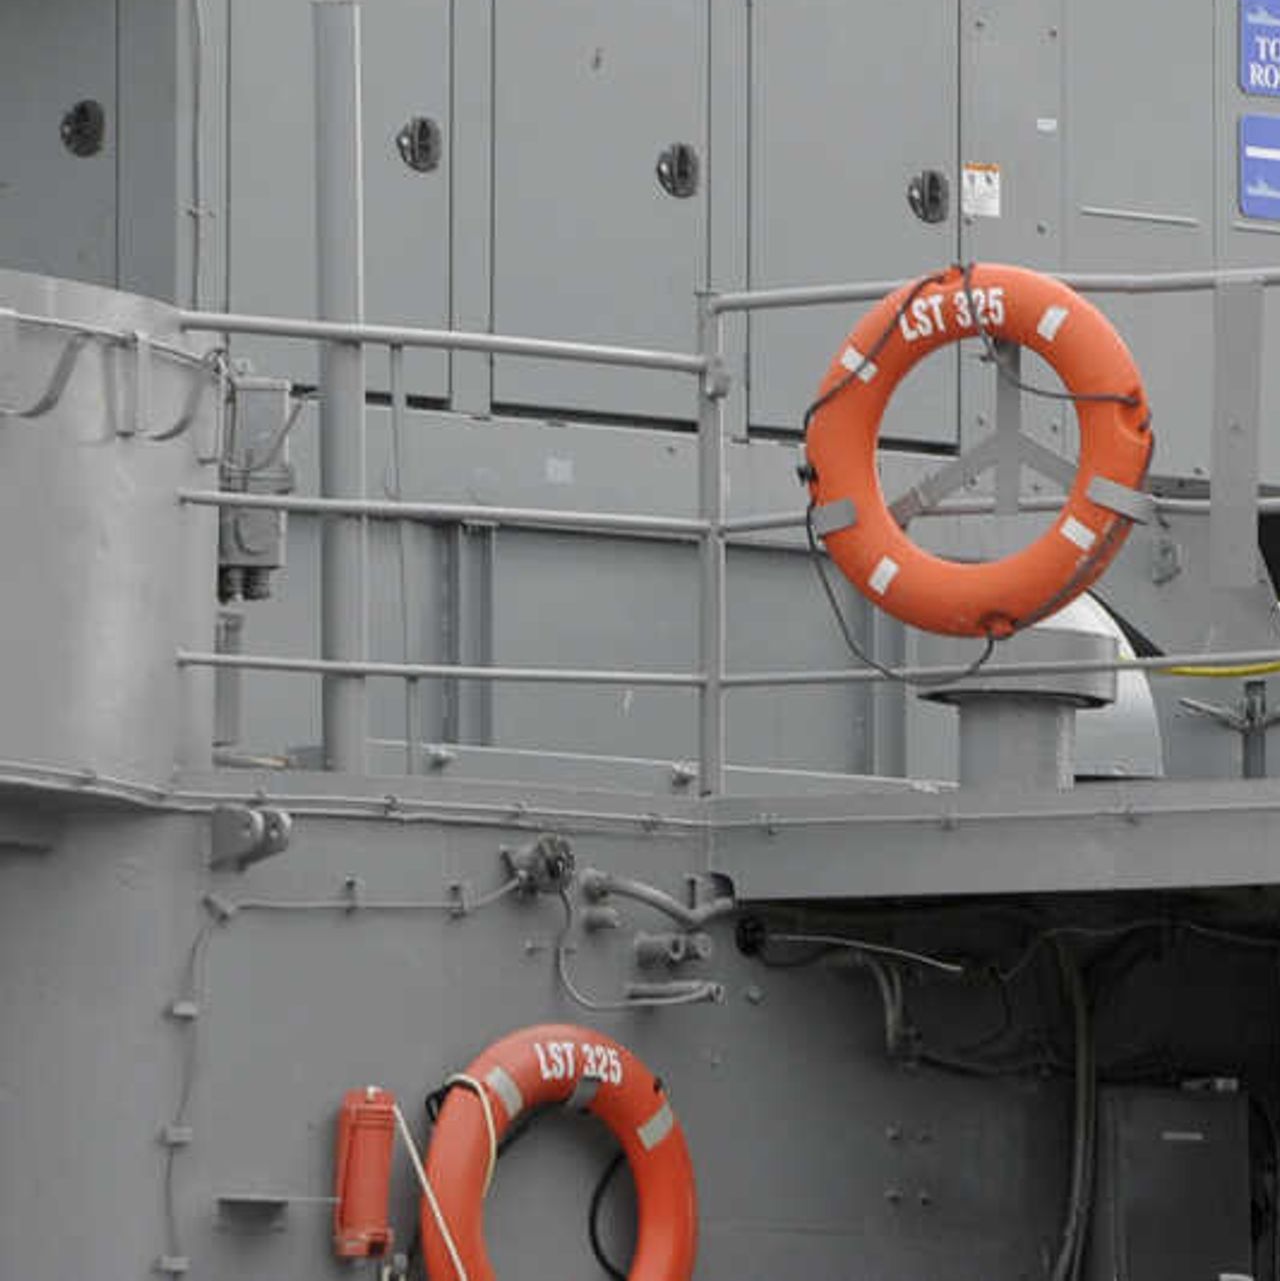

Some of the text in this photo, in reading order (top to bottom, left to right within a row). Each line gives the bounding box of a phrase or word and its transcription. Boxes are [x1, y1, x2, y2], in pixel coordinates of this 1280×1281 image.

[899, 286, 1004, 342] LST 325
[534, 1041, 624, 1086] LST 325
